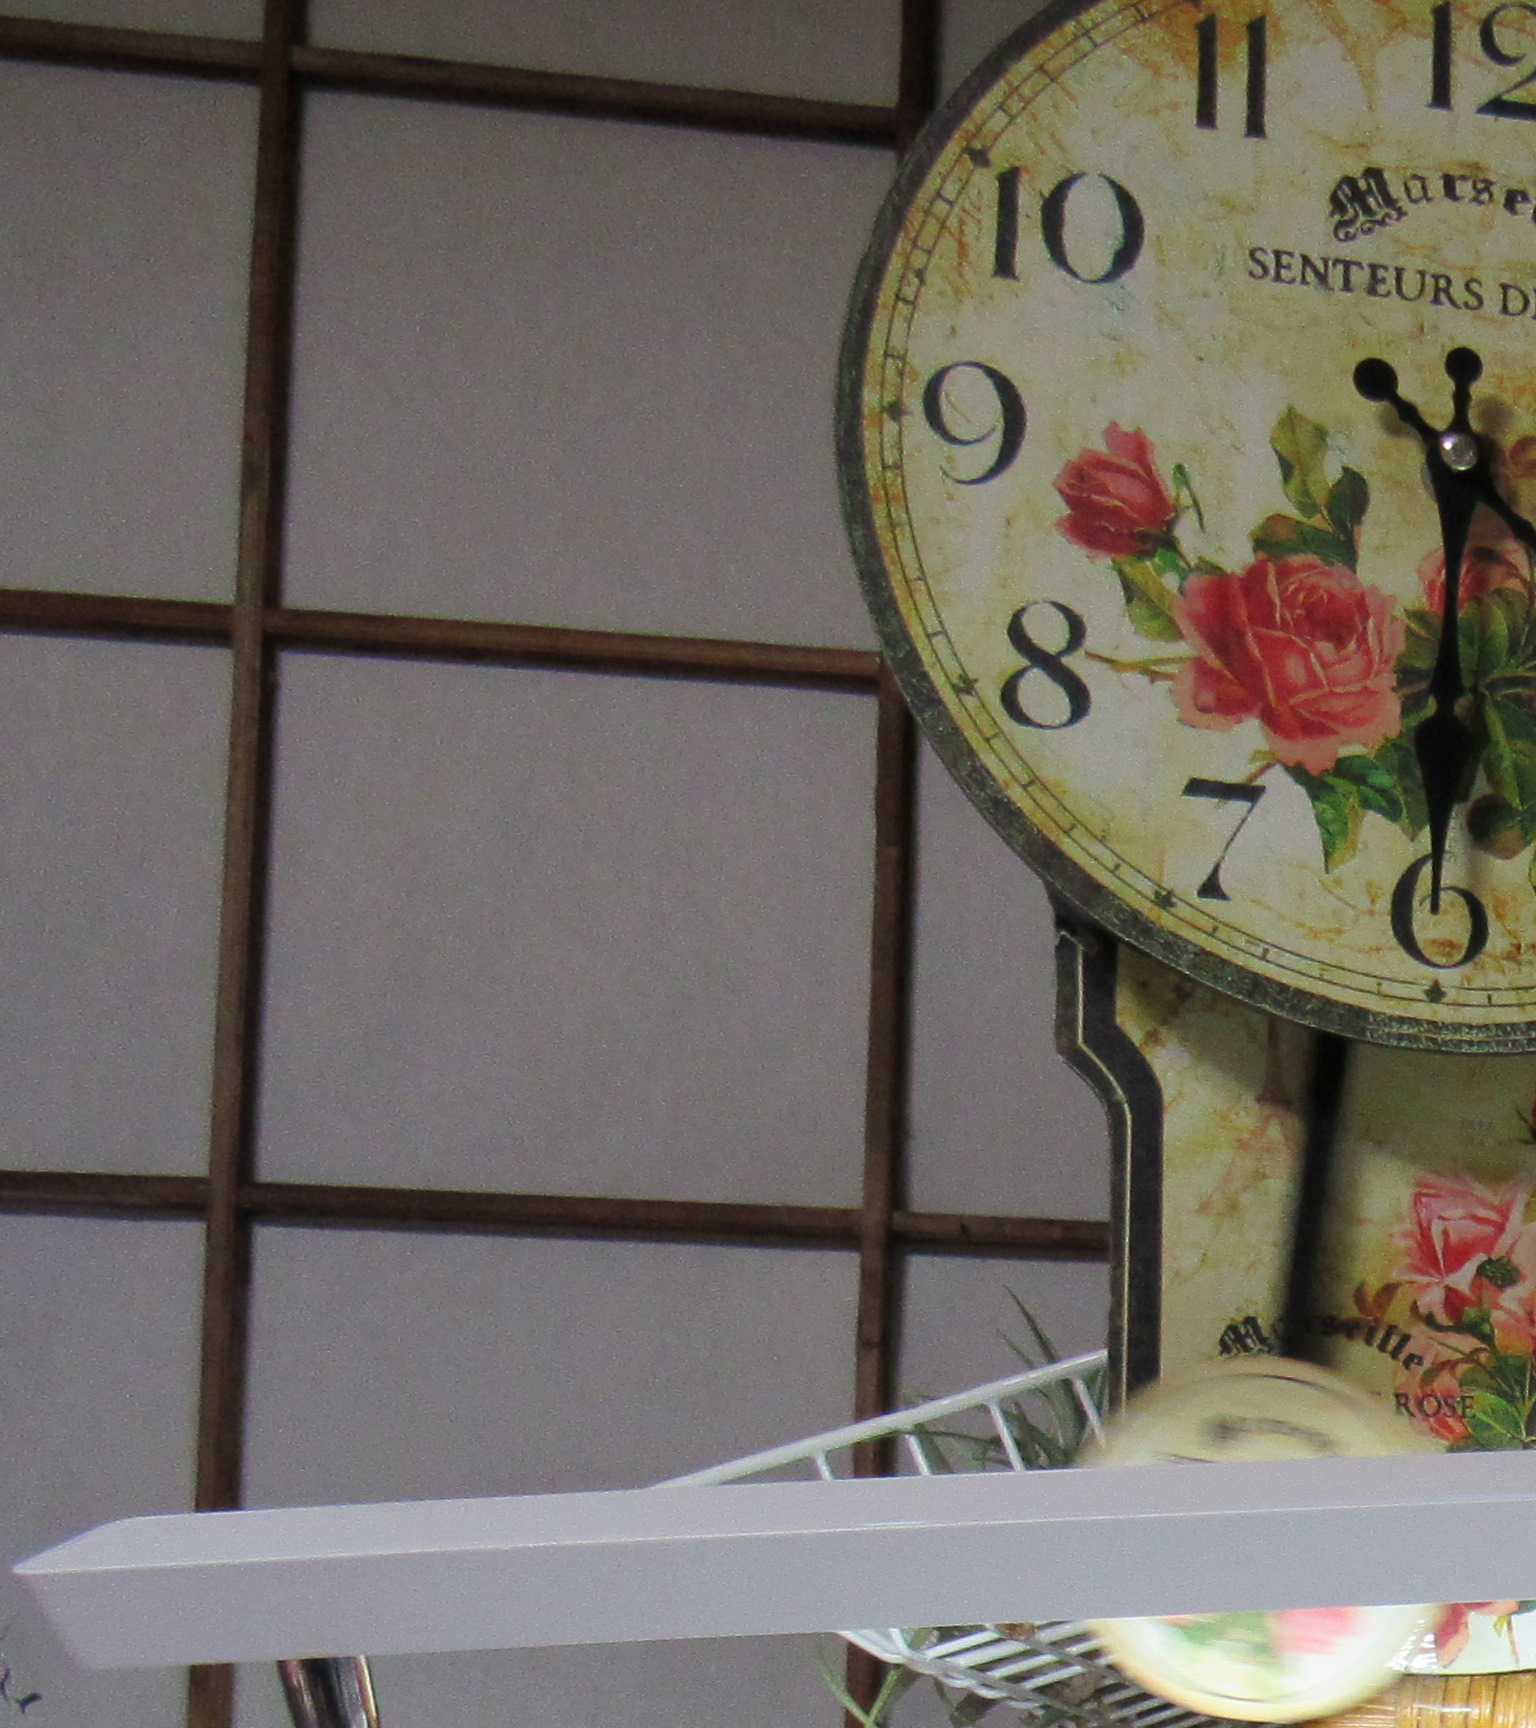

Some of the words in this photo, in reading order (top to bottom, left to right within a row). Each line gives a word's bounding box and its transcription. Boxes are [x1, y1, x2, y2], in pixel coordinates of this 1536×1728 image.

[1194, 14, 1269, 139] 11
[992, 167, 1145, 283] 10
[1247, 246, 1485, 311] SENTEURS
[921, 361, 1028, 485] 9
[997, 600, 1092, 730] 8
[1181, 778, 1267, 902] 7
[1390, 839, 1489, 971] 6
[1394, 1392, 1475, 1420] ROSE
